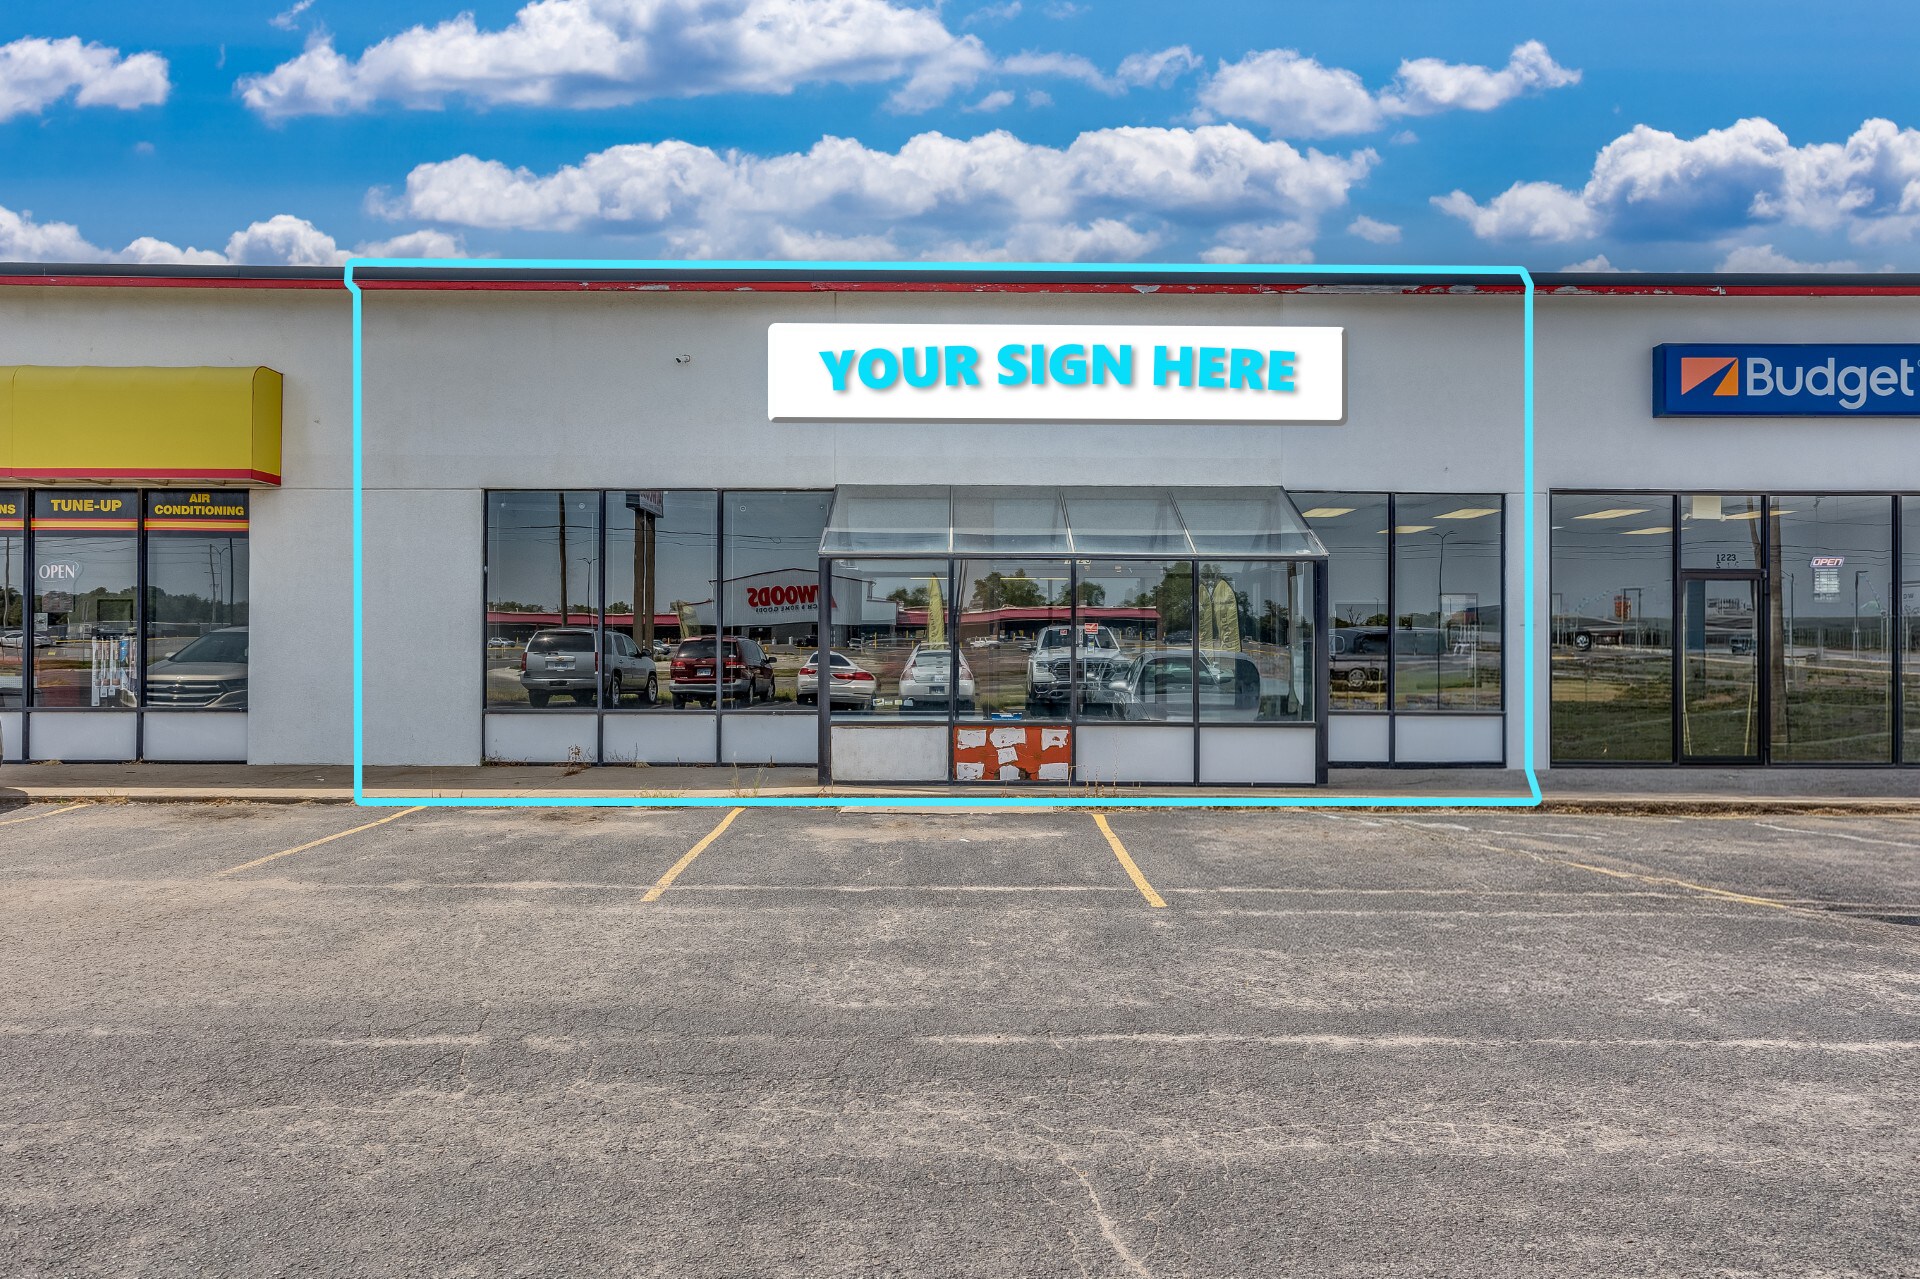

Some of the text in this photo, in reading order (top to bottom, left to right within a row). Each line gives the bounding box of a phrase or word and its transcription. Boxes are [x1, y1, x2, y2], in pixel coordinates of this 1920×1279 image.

[1746, 357, 1915, 410] Budget
[188, 493, 211, 503] AIR
[50, 499, 123, 512] TUNE-UP
[154, 504, 245, 516] CONDITIONING
[1716, 553, 1737, 562] 1223
[1812, 558, 1843, 566] OPEN
[38, 564, 75, 579] OPEN
